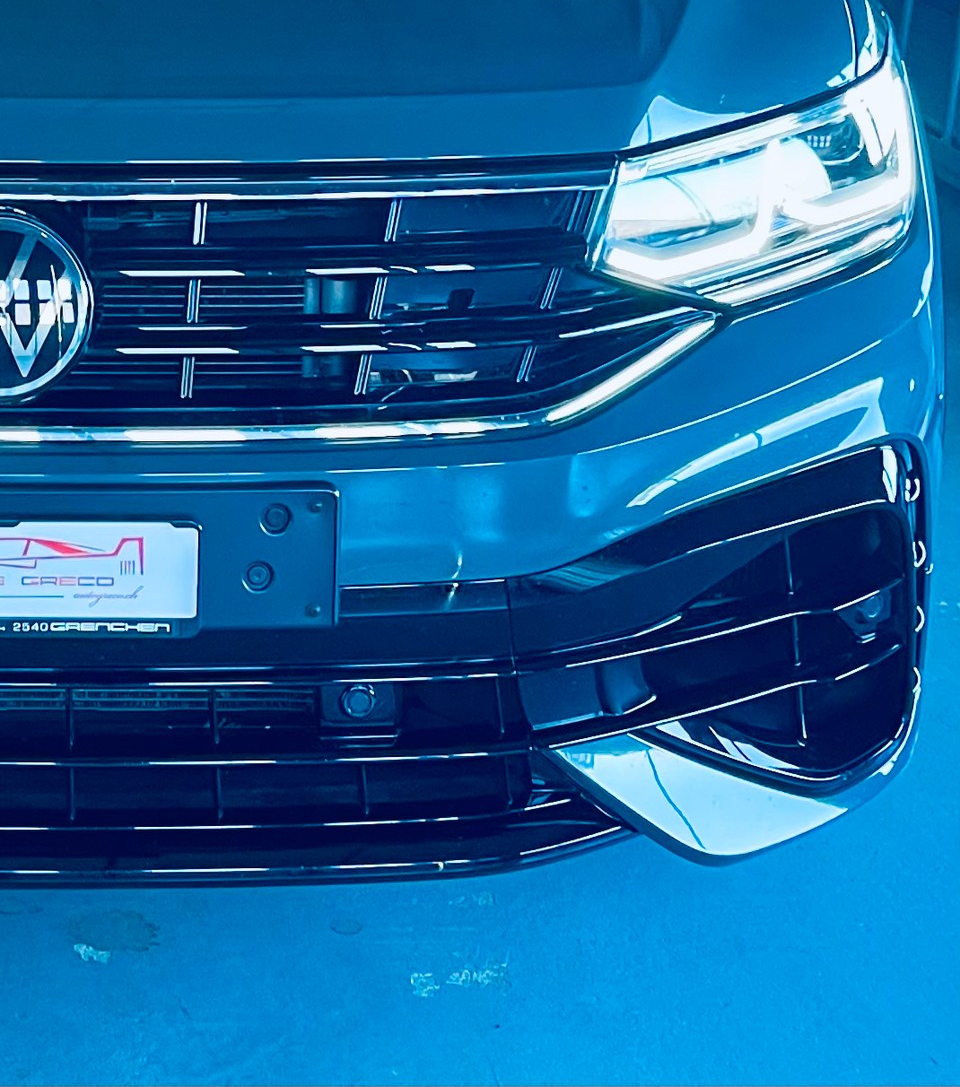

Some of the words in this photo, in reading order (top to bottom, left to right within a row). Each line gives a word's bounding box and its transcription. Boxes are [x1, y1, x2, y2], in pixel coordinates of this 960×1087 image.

[21, 575, 115, 587] GRECO
[12, 621, 49, 633] 2540
[49, 621, 171, 633] GRENCHEN
